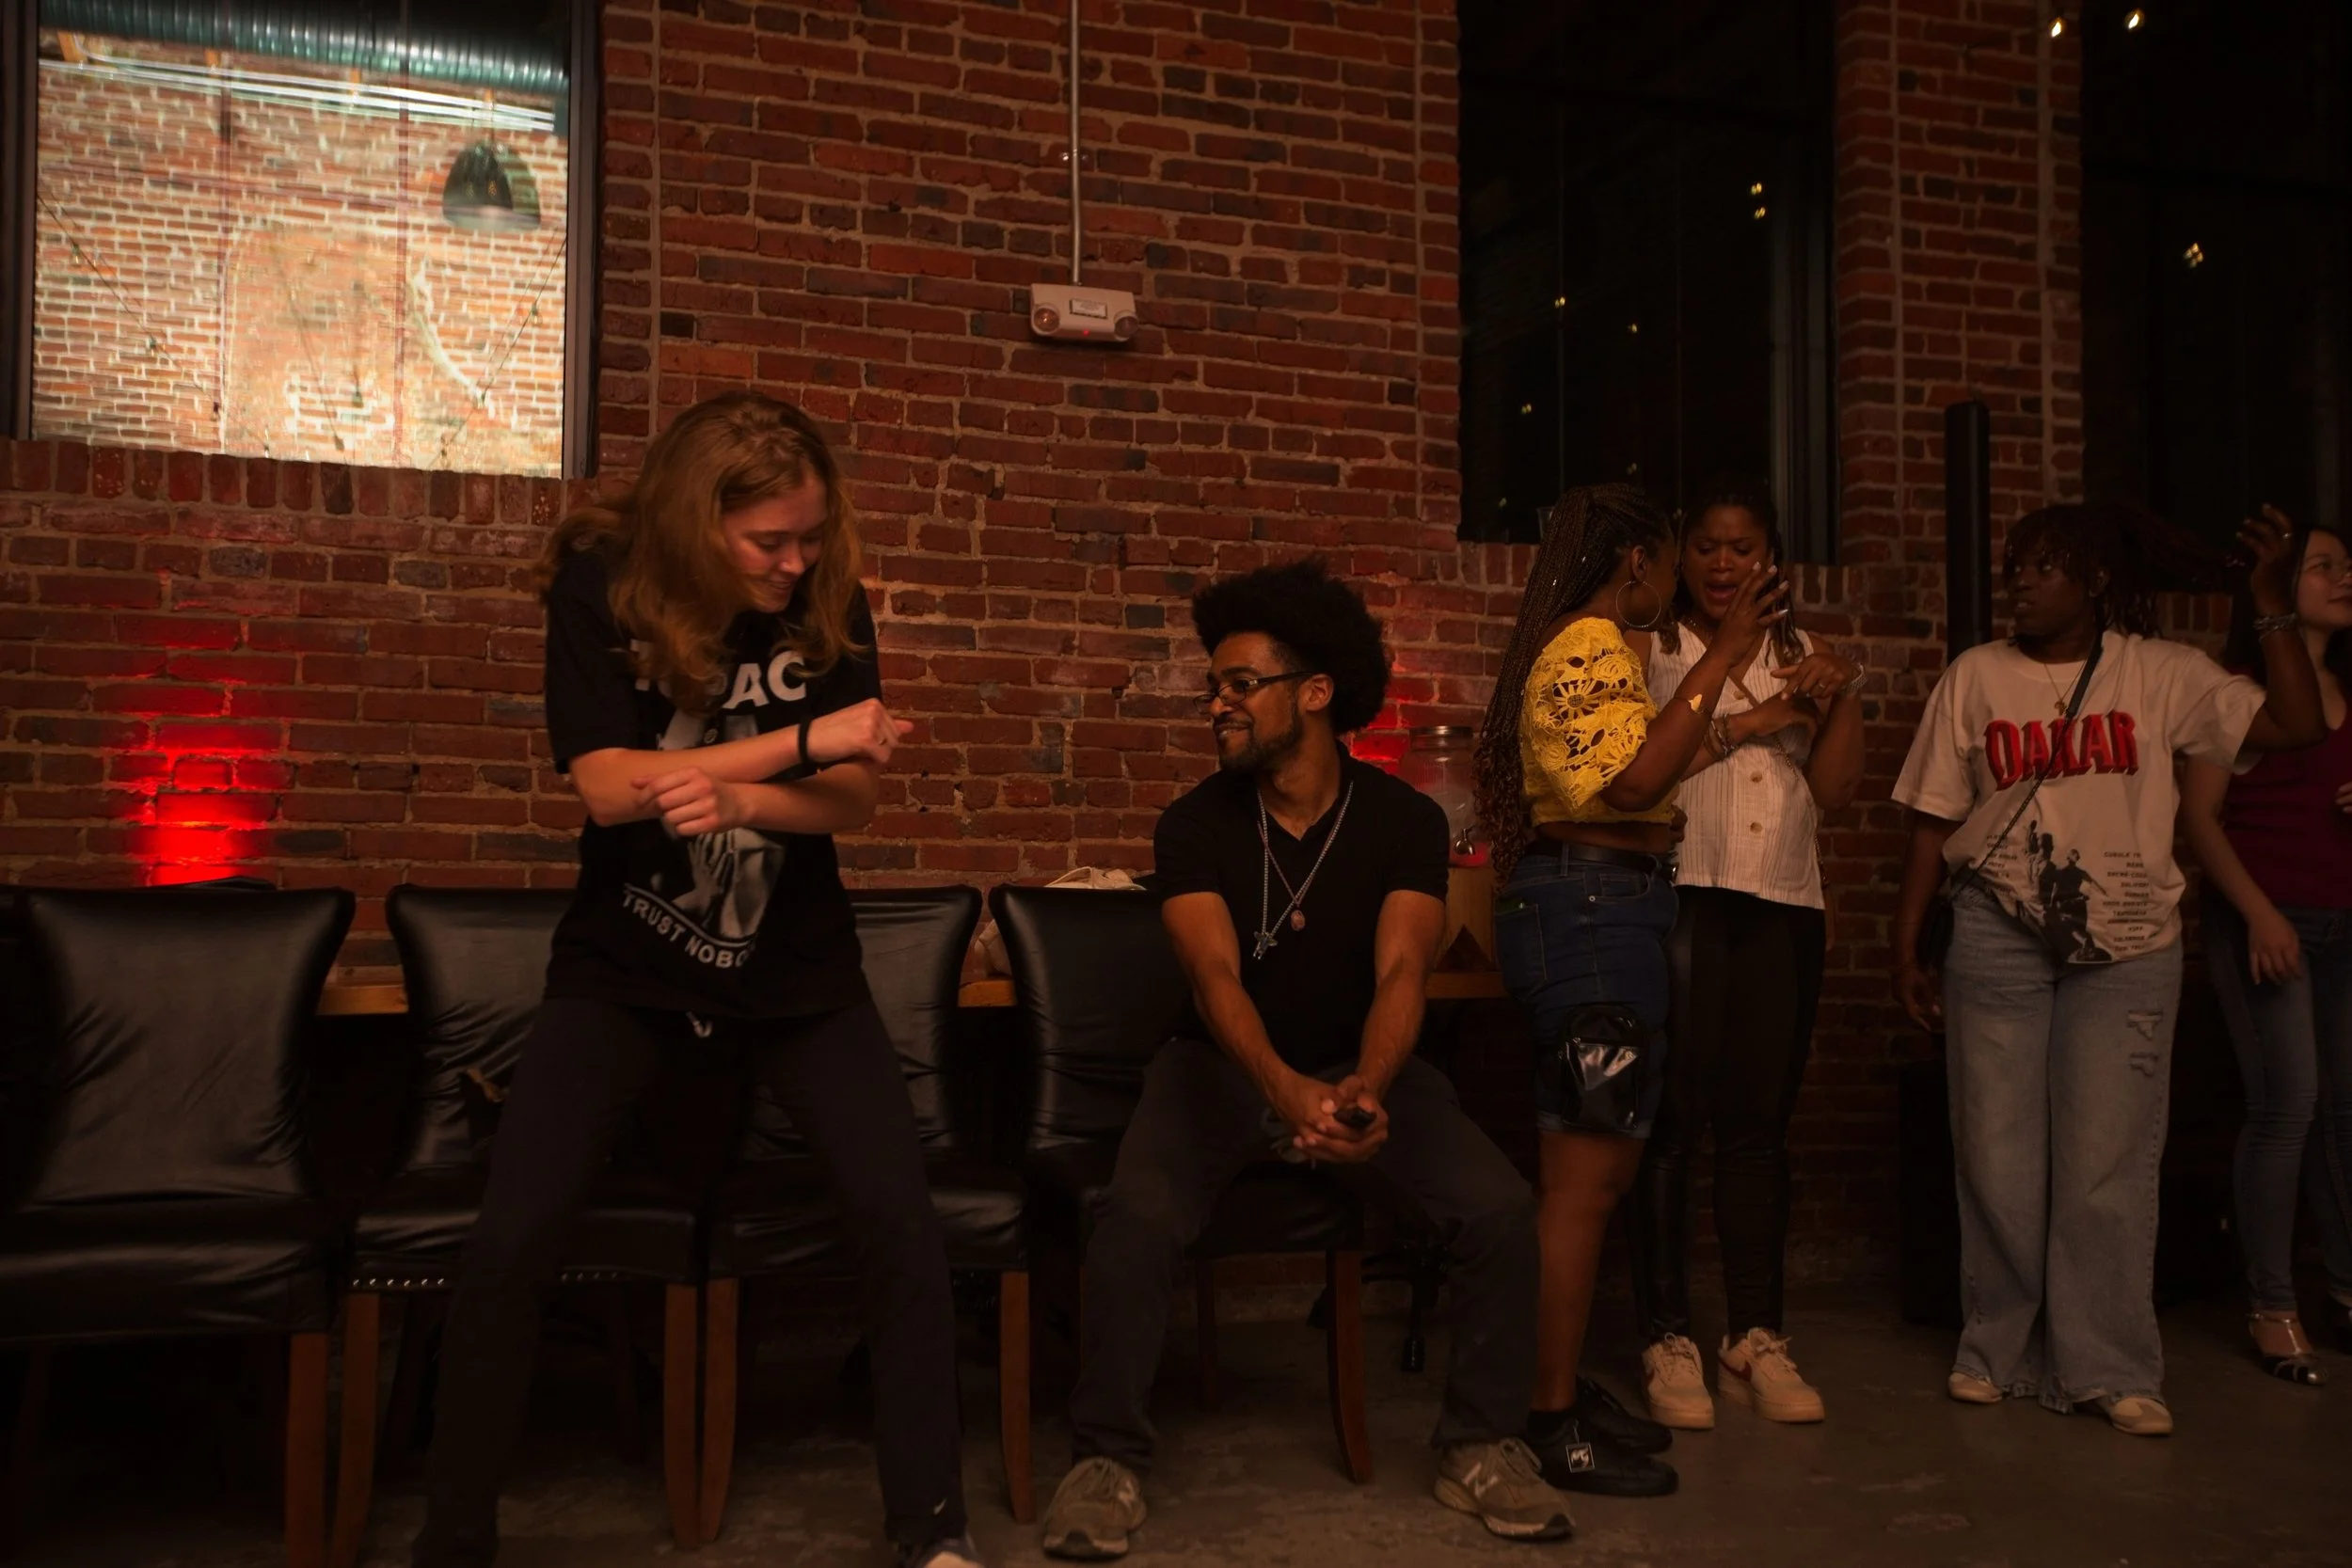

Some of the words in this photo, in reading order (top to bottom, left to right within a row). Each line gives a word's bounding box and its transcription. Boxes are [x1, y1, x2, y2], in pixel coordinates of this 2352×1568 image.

[1983, 709, 2137, 791] DAKAR
[622, 890, 687, 942] TRUST
[684, 934, 755, 969] NOBO
